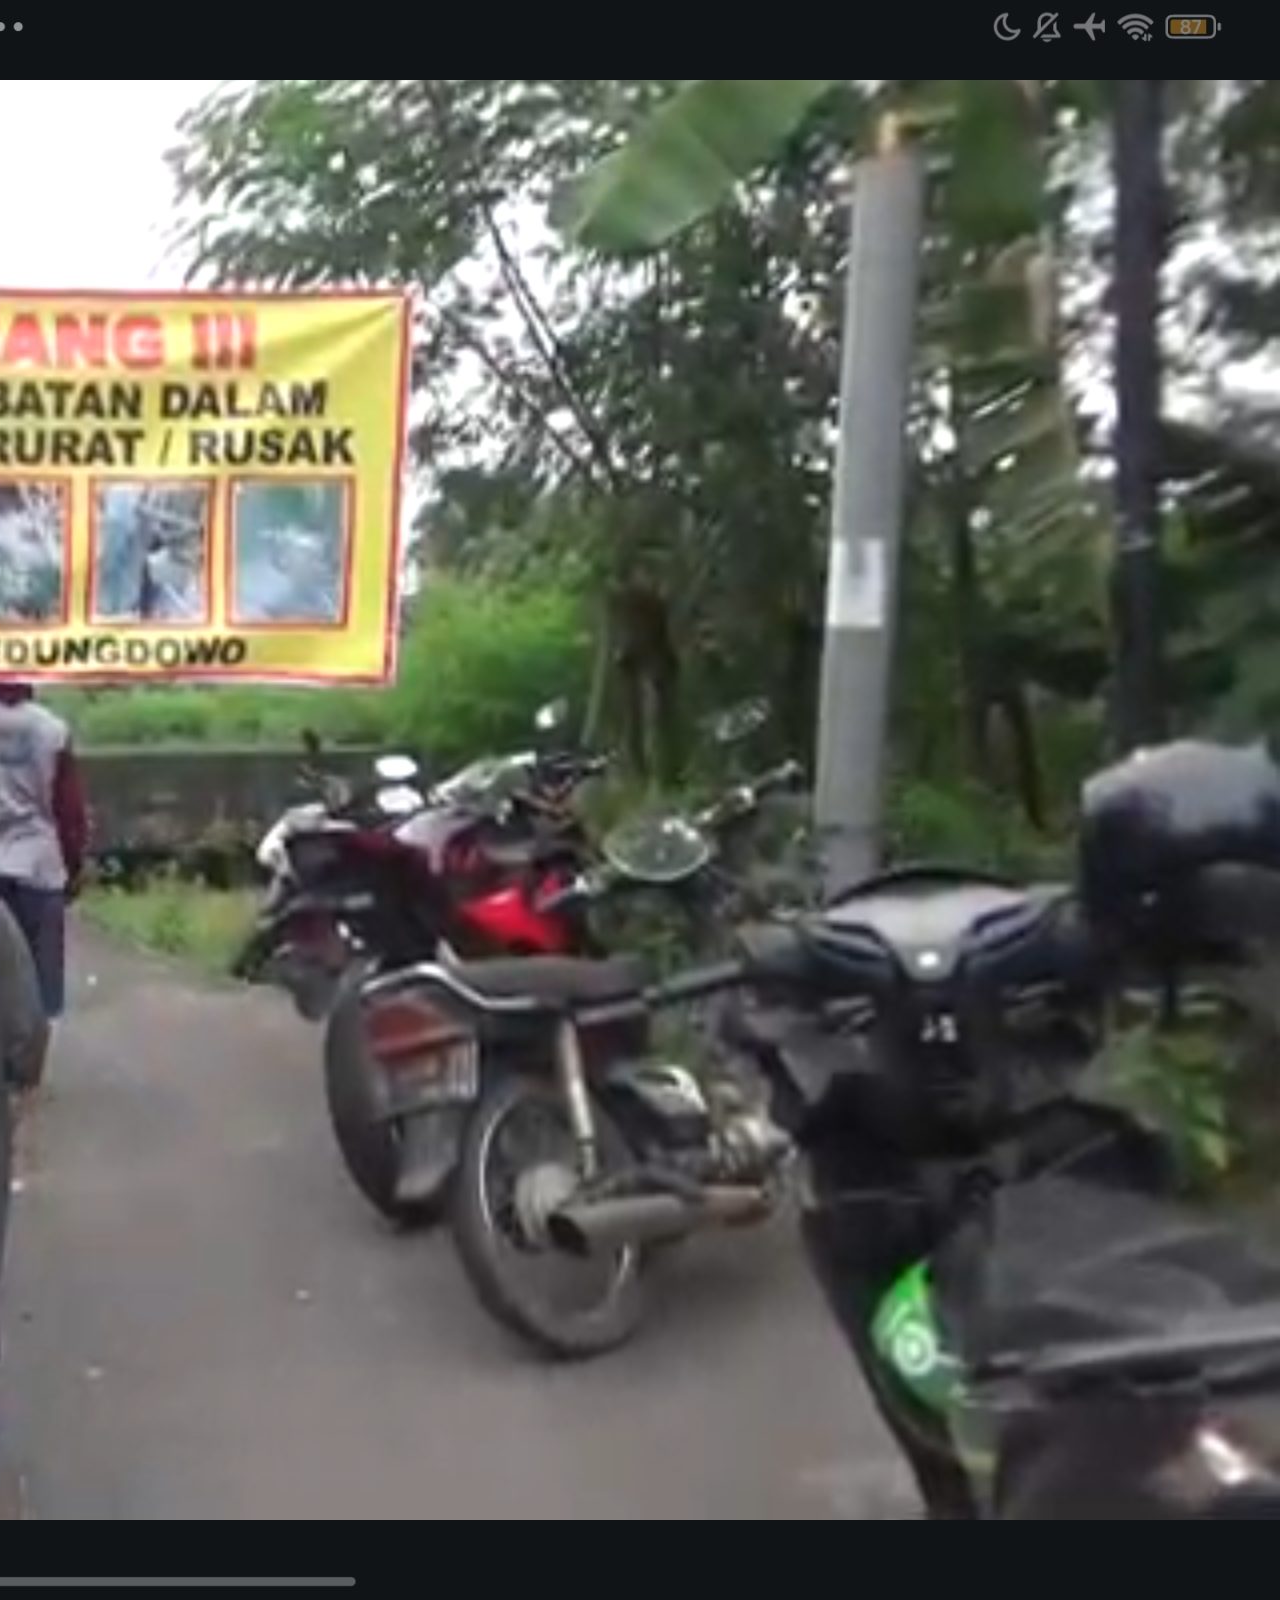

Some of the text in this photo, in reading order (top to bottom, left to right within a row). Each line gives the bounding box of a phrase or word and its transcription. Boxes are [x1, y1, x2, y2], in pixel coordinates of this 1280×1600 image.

[160, 381, 328, 418] DALAM
[158, 430, 175, 466] /
[189, 428, 357, 466] RUSAK
